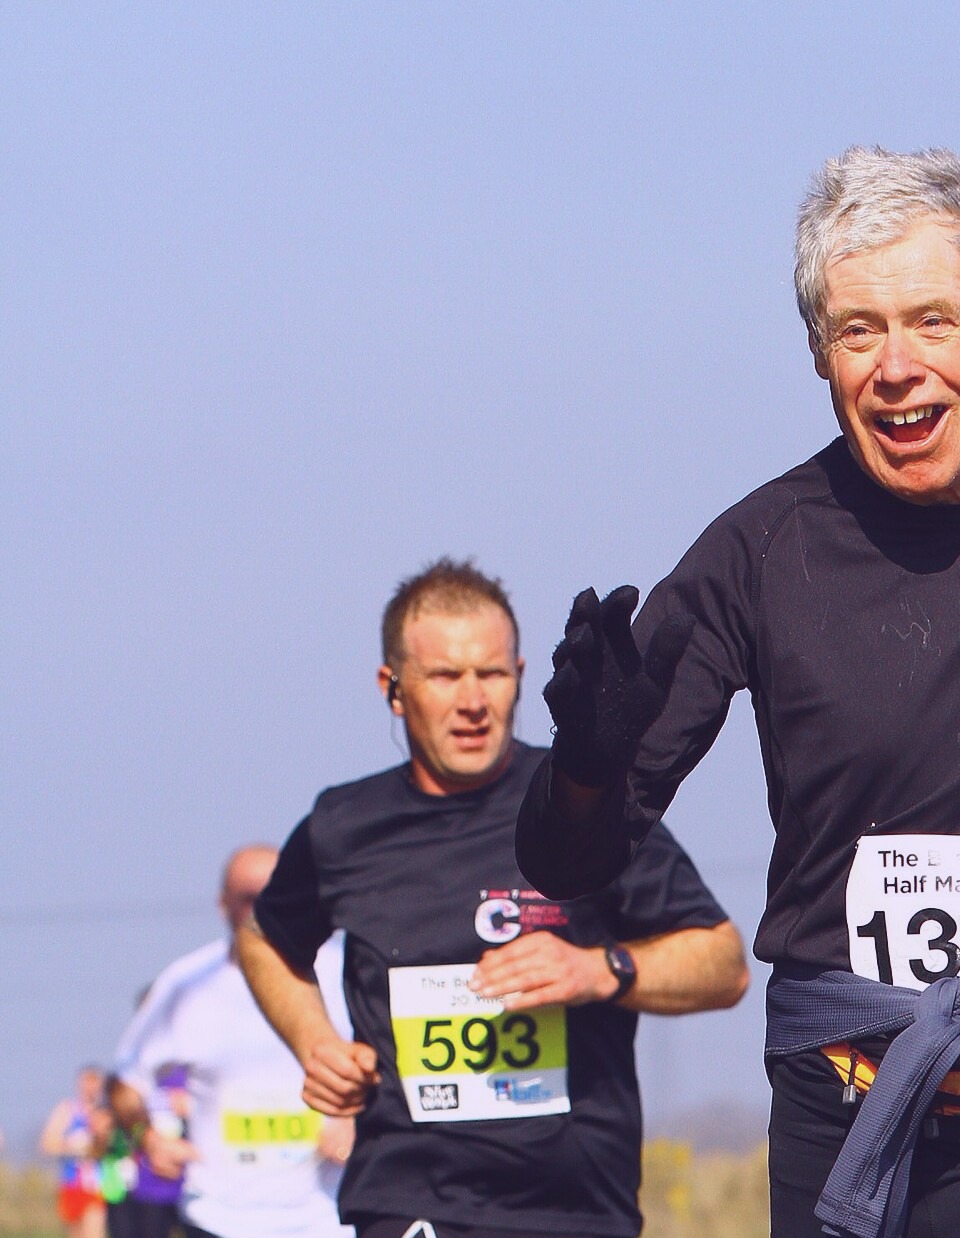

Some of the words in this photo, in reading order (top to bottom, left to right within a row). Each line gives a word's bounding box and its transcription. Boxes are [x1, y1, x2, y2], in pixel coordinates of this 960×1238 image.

[878, 850, 919, 867] The
[884, 875, 927, 894] Half
[420, 1014, 539, 1073] 593
[243, 1115, 306, 1141] 110
